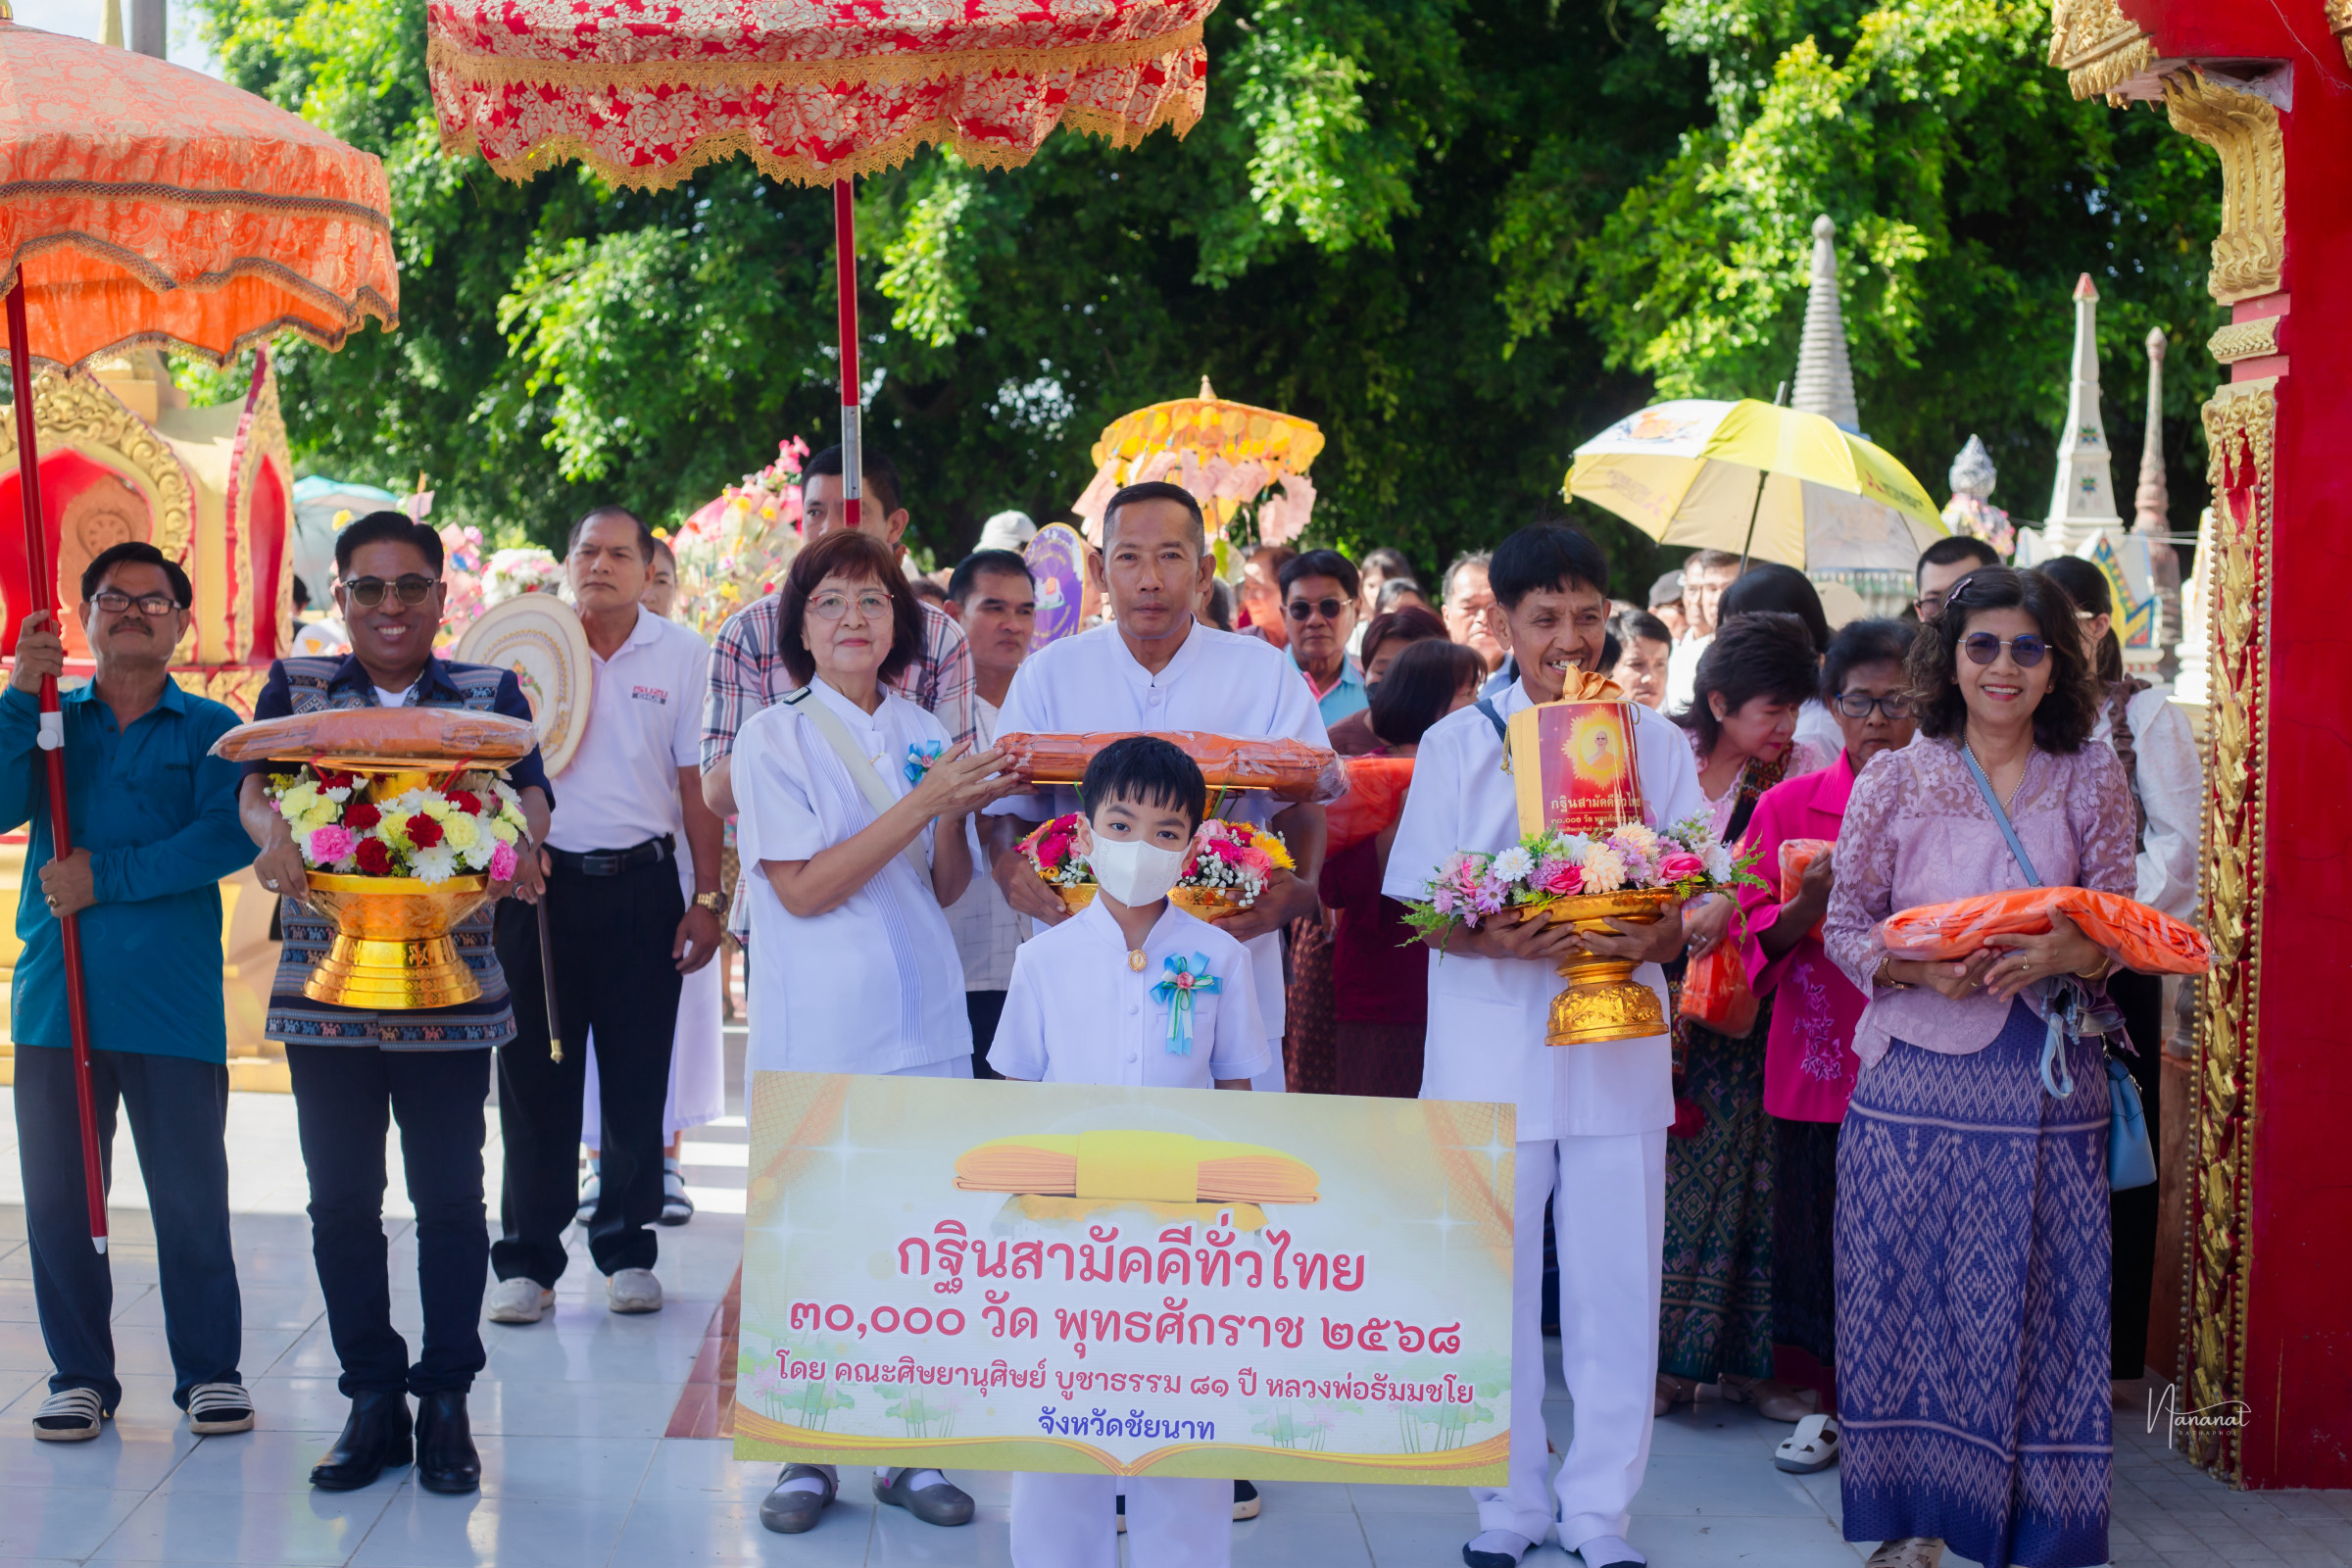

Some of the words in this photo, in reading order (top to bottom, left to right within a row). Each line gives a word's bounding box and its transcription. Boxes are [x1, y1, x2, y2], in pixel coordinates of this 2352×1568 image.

[632, 685, 668, 699] ISUZU
[897, 1213, 1366, 1295] กฐินสามัคคีทั่วไทย
[790, 1302, 966, 1340] ๓๐,๐๐๐
[981, 1290, 1039, 1340] วัด
[1054, 1296, 1305, 1360] พุทธศักราช
[1320, 1315, 1461, 1355] ๒๕๖๘
[775, 1348, 826, 1381] โดย
[834, 1355, 1048, 1397] คณะศิษยานุศิษย์
[1054, 1370, 1182, 1401] บูชาธรรม
[1190, 1374, 1230, 1398] ๘๑
[1237, 1366, 1258, 1397] ปี
[1265, 1372, 1474, 1404] หลวงพ่อธัมมชโย
[1037, 1405, 1216, 1441] จังหวัดชัยนาท
